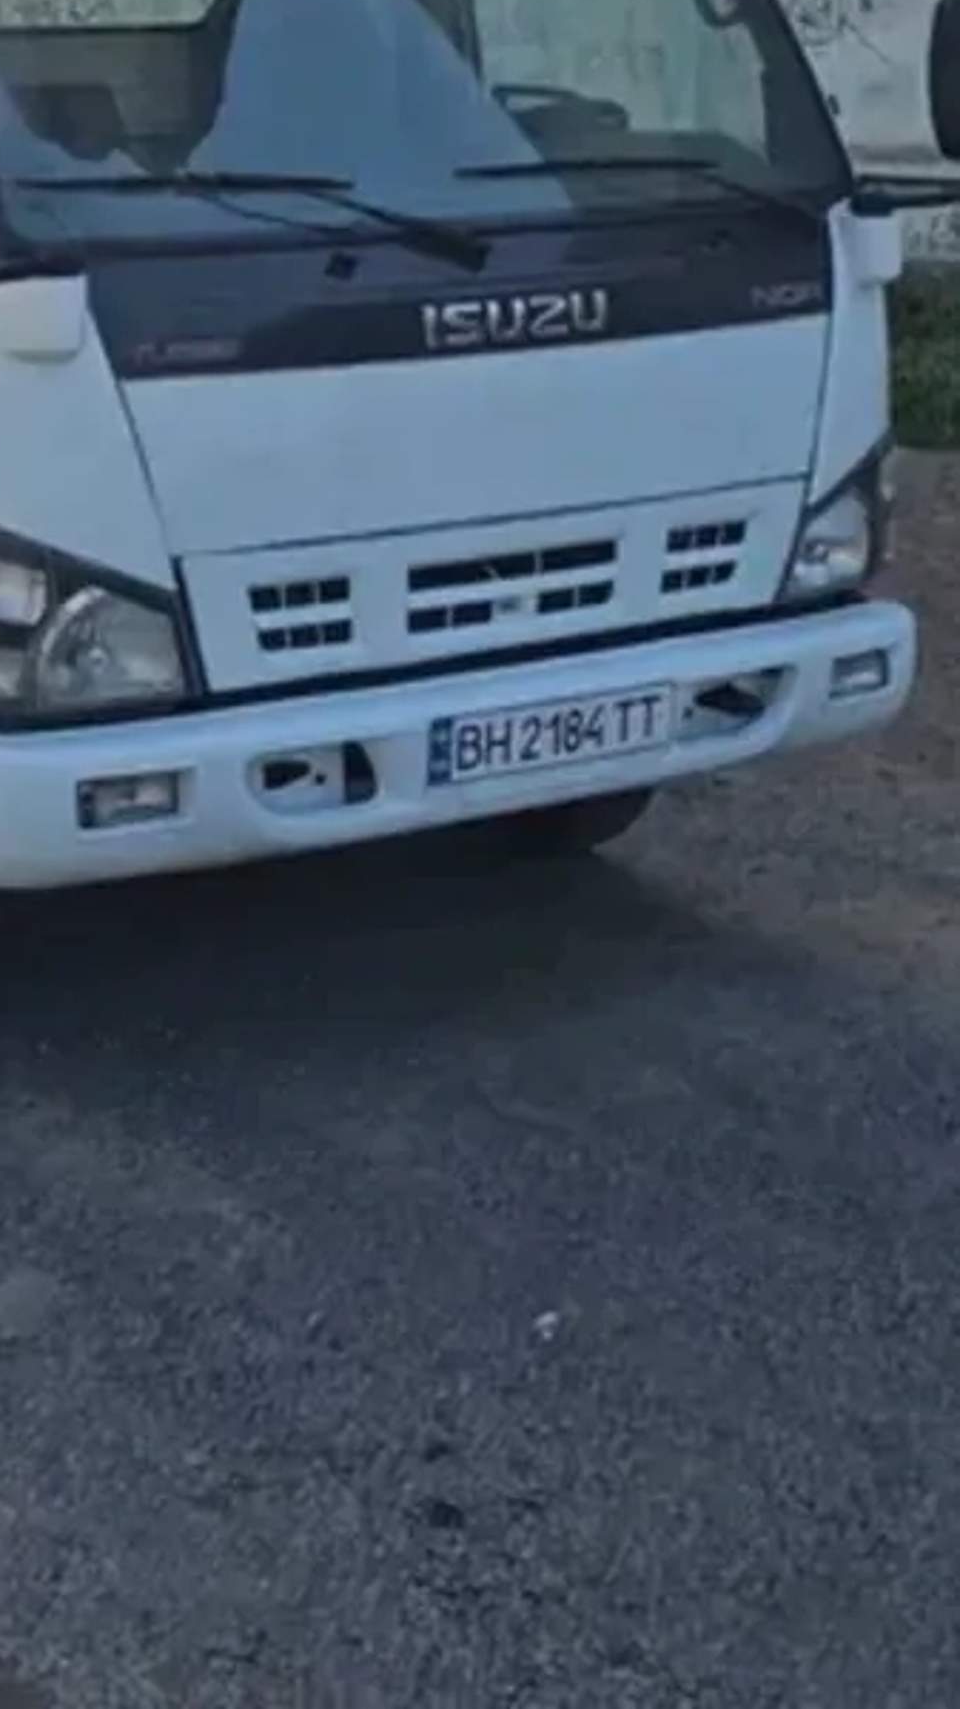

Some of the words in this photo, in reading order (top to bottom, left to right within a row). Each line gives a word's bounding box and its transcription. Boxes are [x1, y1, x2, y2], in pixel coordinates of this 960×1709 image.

[422, 290, 608, 349] ISUZU
[456, 719, 512, 771] BH
[520, 703, 604, 761] 2184
[614, 693, 663, 742] TT
